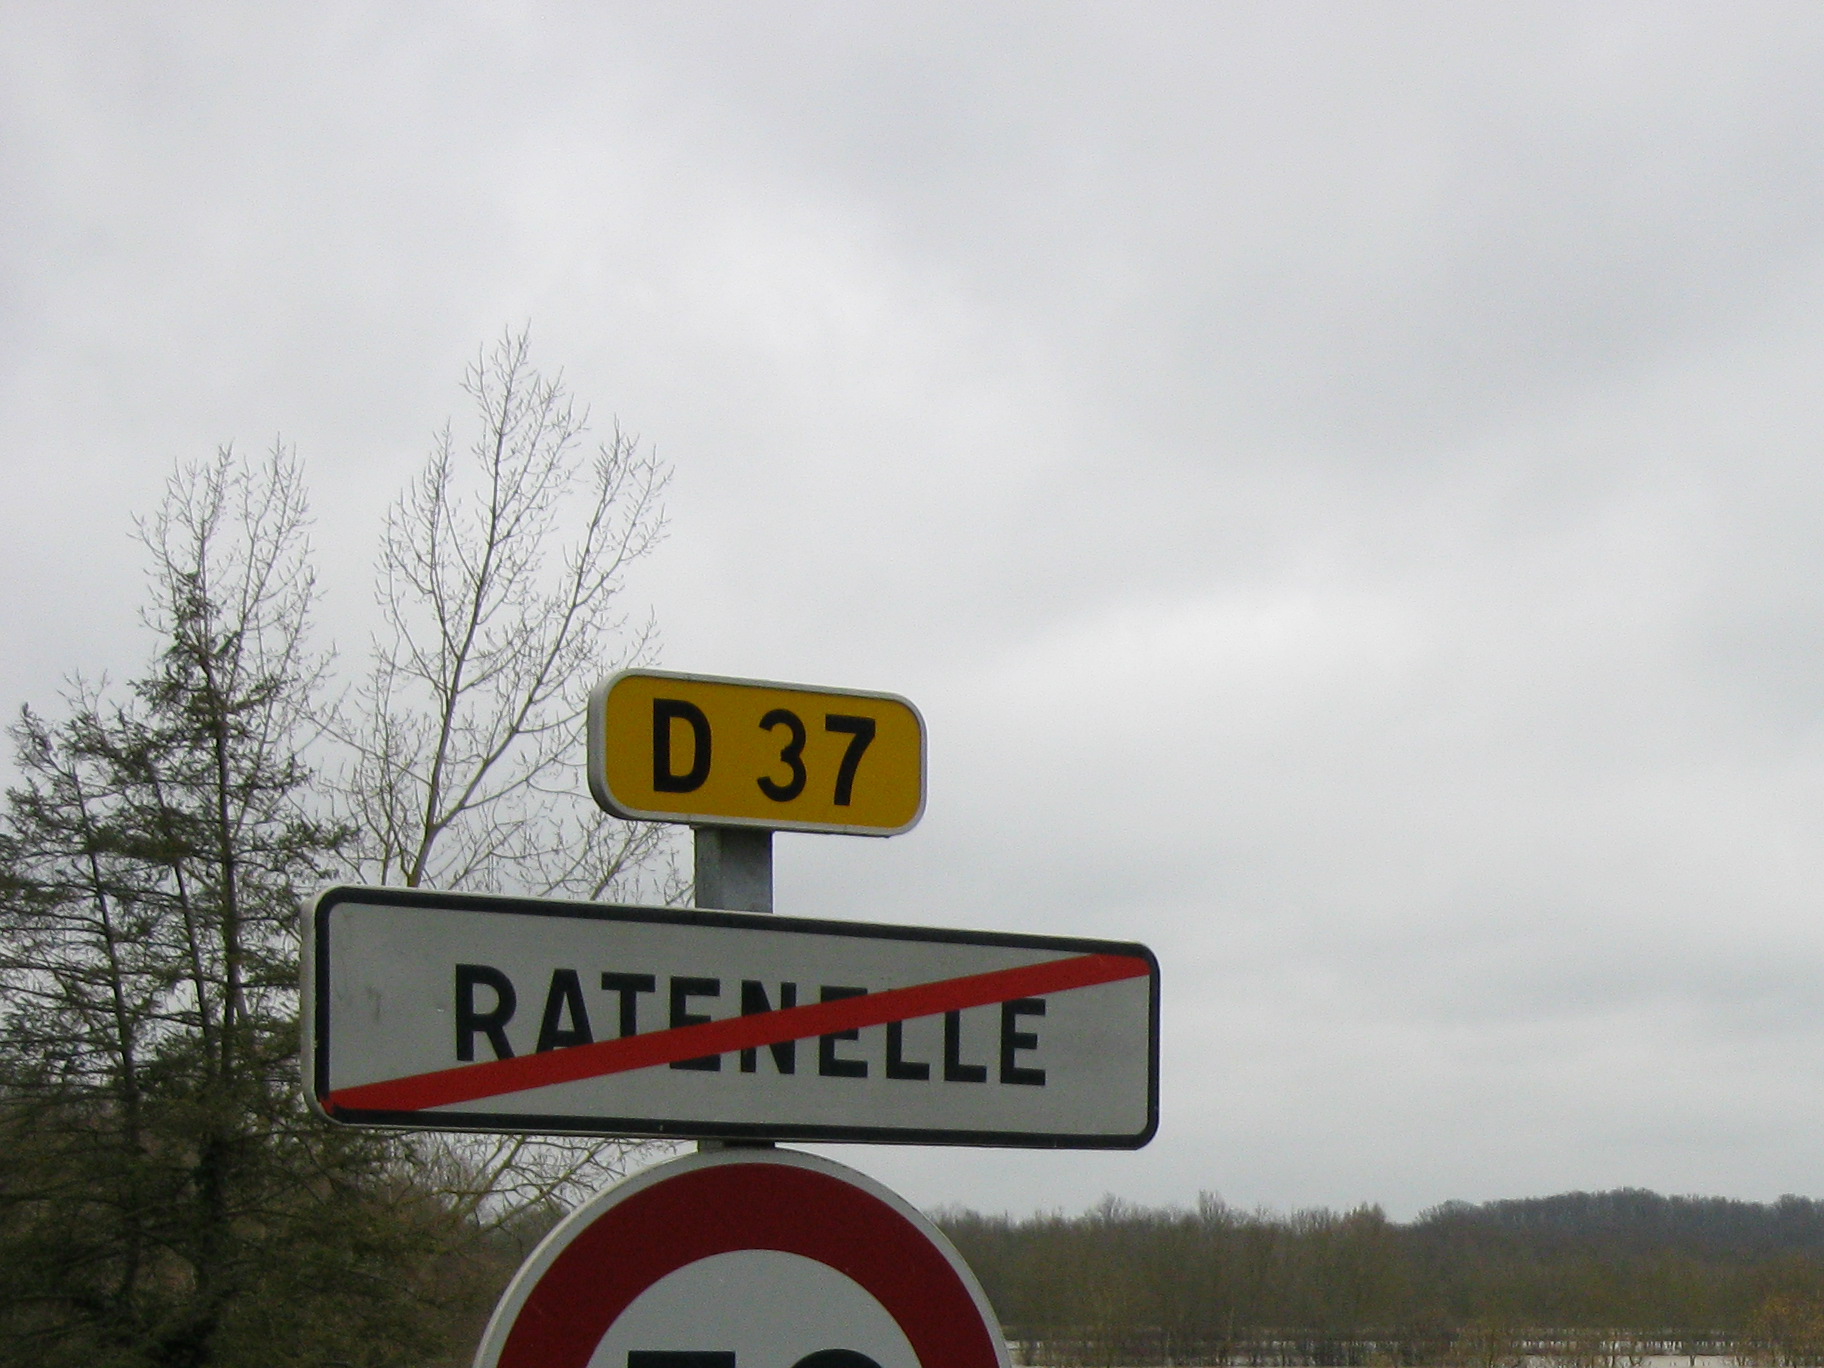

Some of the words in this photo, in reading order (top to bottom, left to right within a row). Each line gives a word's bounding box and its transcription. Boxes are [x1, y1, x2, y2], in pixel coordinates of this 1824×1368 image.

[652, 697, 713, 795] D
[755, 707, 878, 808] 37
[454, 962, 1048, 1087] RATENELLE
